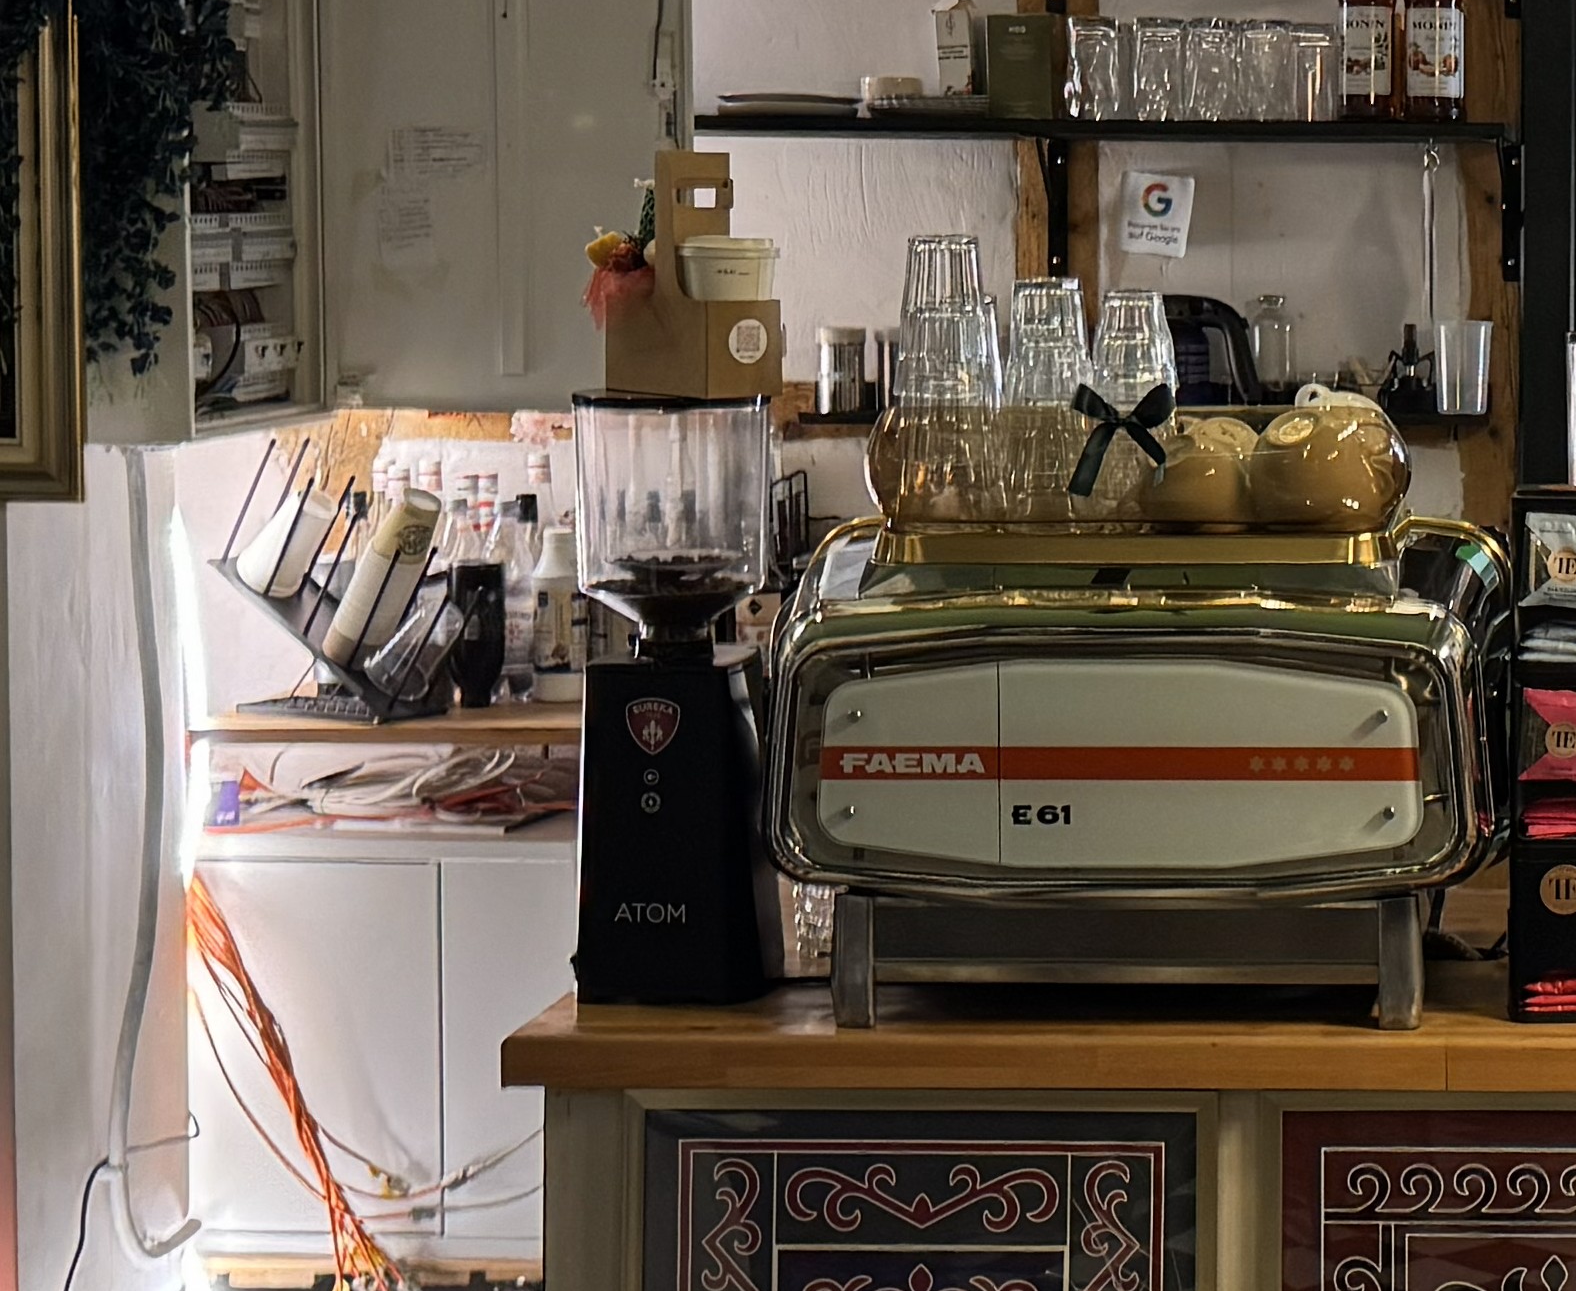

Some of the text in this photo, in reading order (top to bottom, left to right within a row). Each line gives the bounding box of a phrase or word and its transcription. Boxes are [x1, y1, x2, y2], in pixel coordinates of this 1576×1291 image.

[1146, 231, 1178, 245] Google
[632, 702, 674, 714] EUREKA
[840, 753, 985, 773] FAEMA
[614, 903, 686, 923] ATOM
